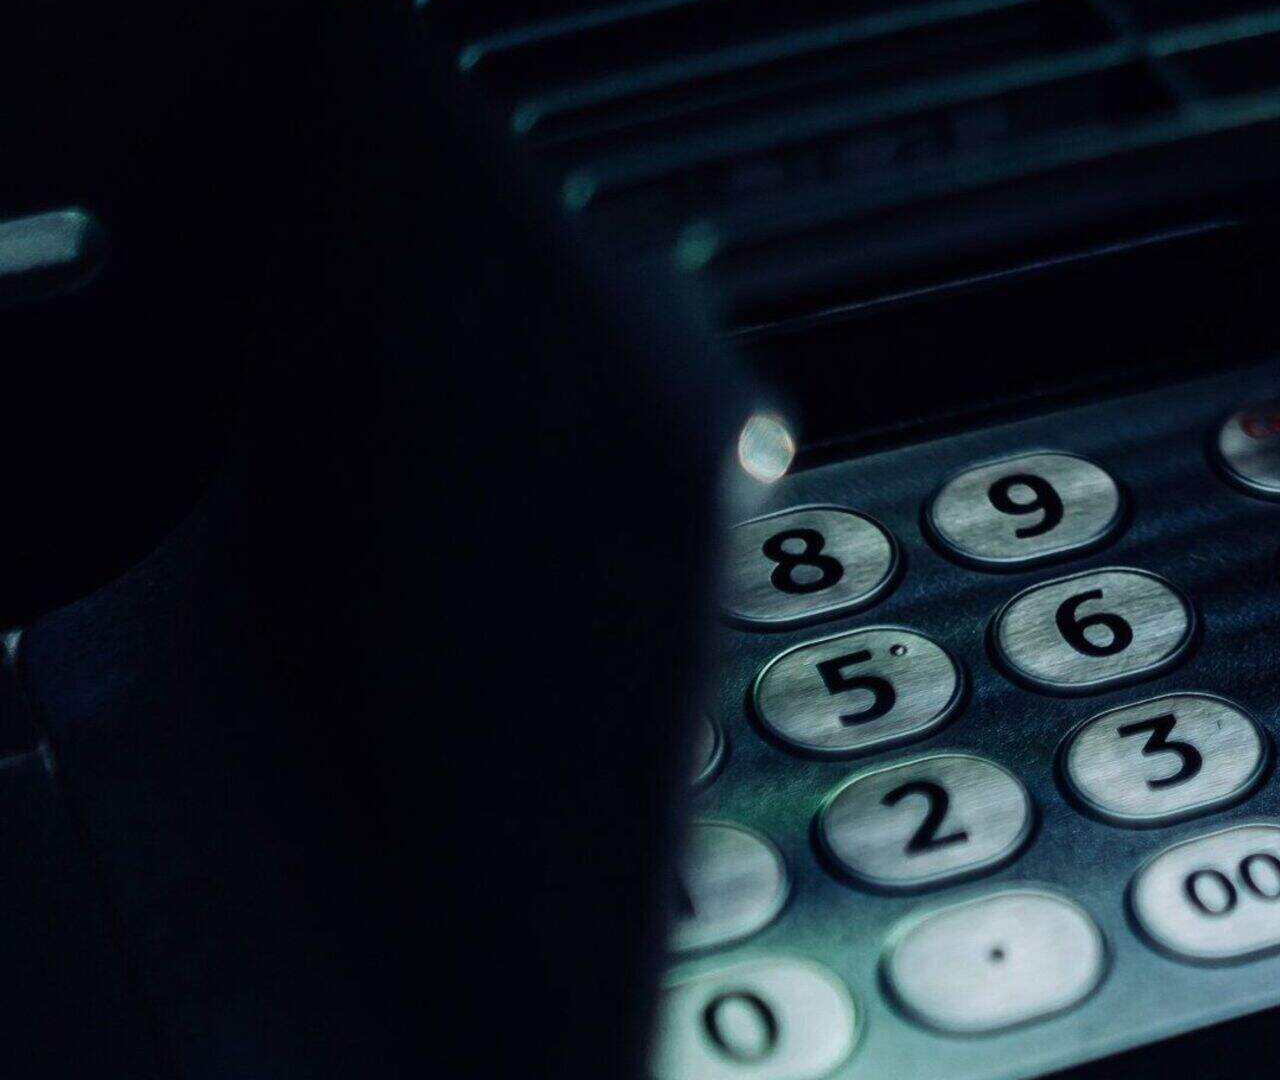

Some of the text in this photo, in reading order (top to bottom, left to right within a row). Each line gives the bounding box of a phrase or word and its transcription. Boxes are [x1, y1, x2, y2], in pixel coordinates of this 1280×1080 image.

[988, 473, 1064, 539] 9
[763, 528, 844, 595] 8
[1056, 589, 1134, 657] 6
[816, 649, 897, 726] 5
[1117, 713, 1203, 789] 3
[880, 779, 968, 855] 2
[704, 990, 778, 1064] 0
